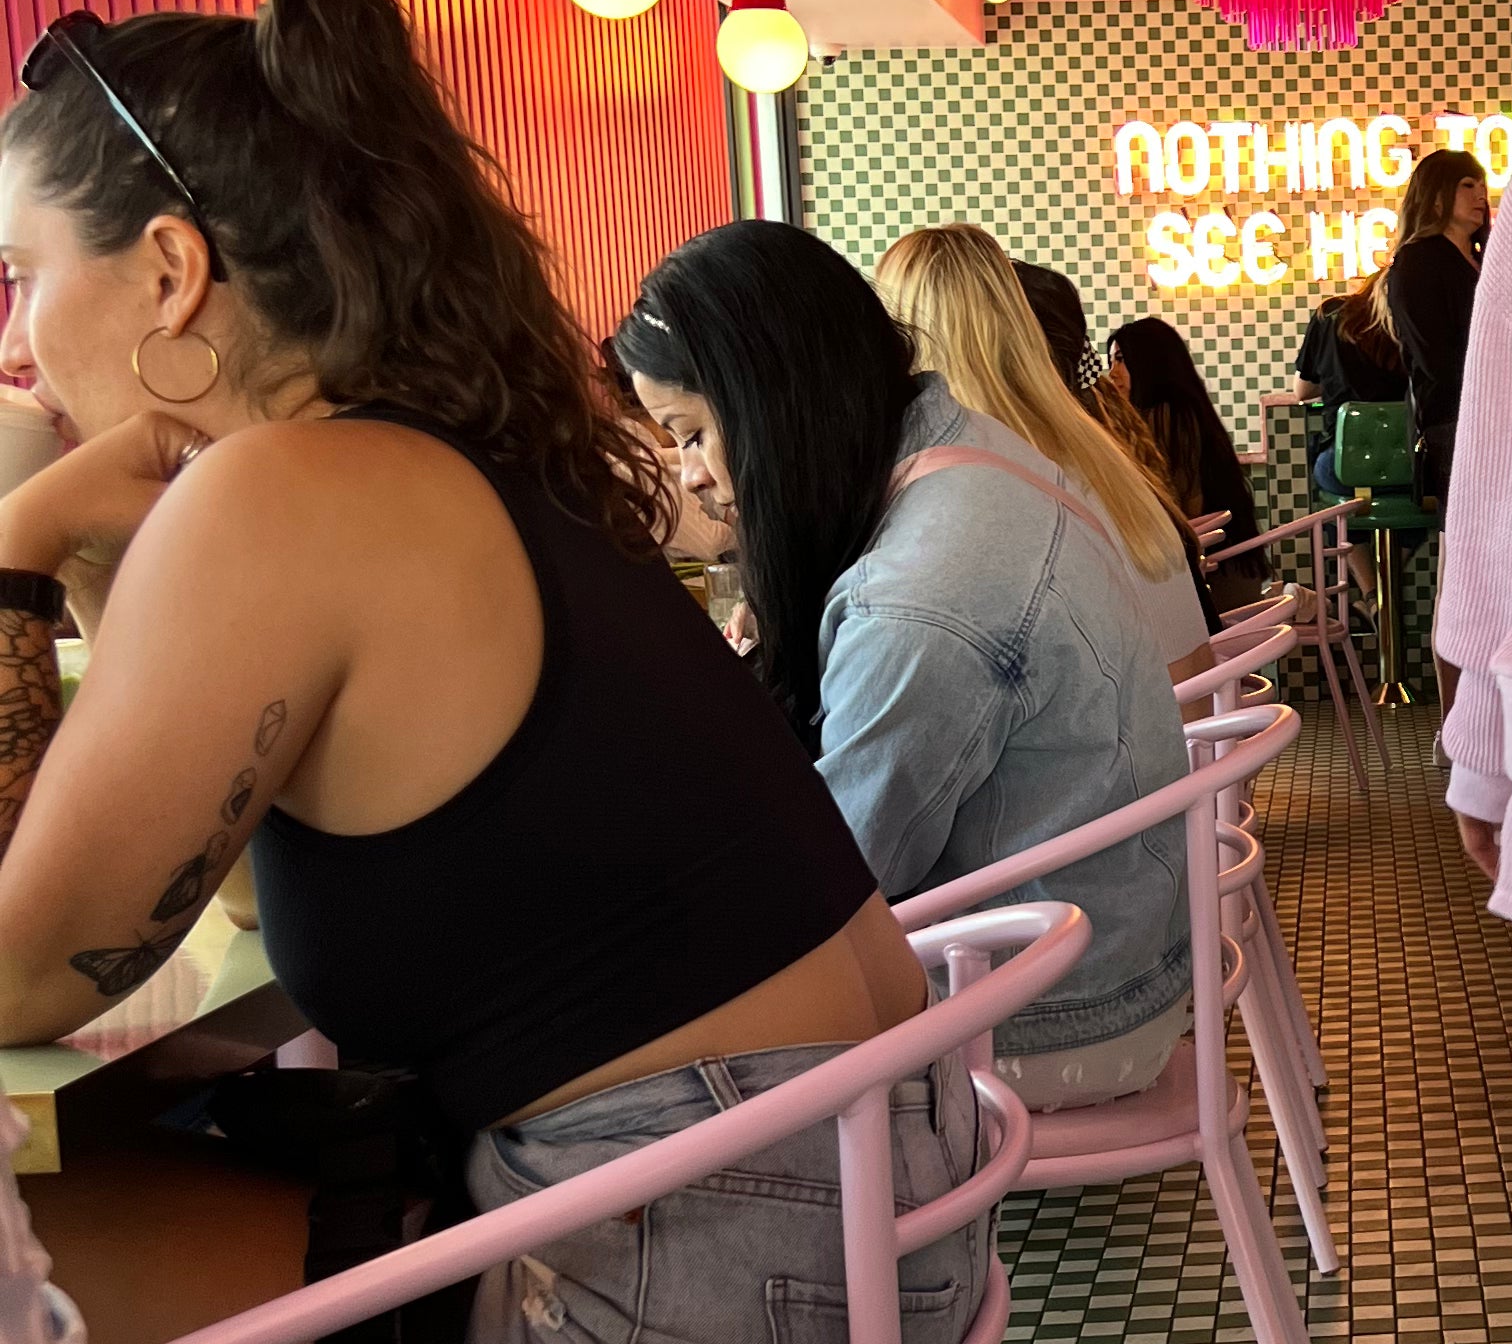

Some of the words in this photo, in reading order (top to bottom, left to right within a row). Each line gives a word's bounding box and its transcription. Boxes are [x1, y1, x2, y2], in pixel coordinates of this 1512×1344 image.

[1114, 114, 1413, 195] NOTHING
[1147, 210, 1287, 287] SEE
[1309, 208, 1399, 282] HE
